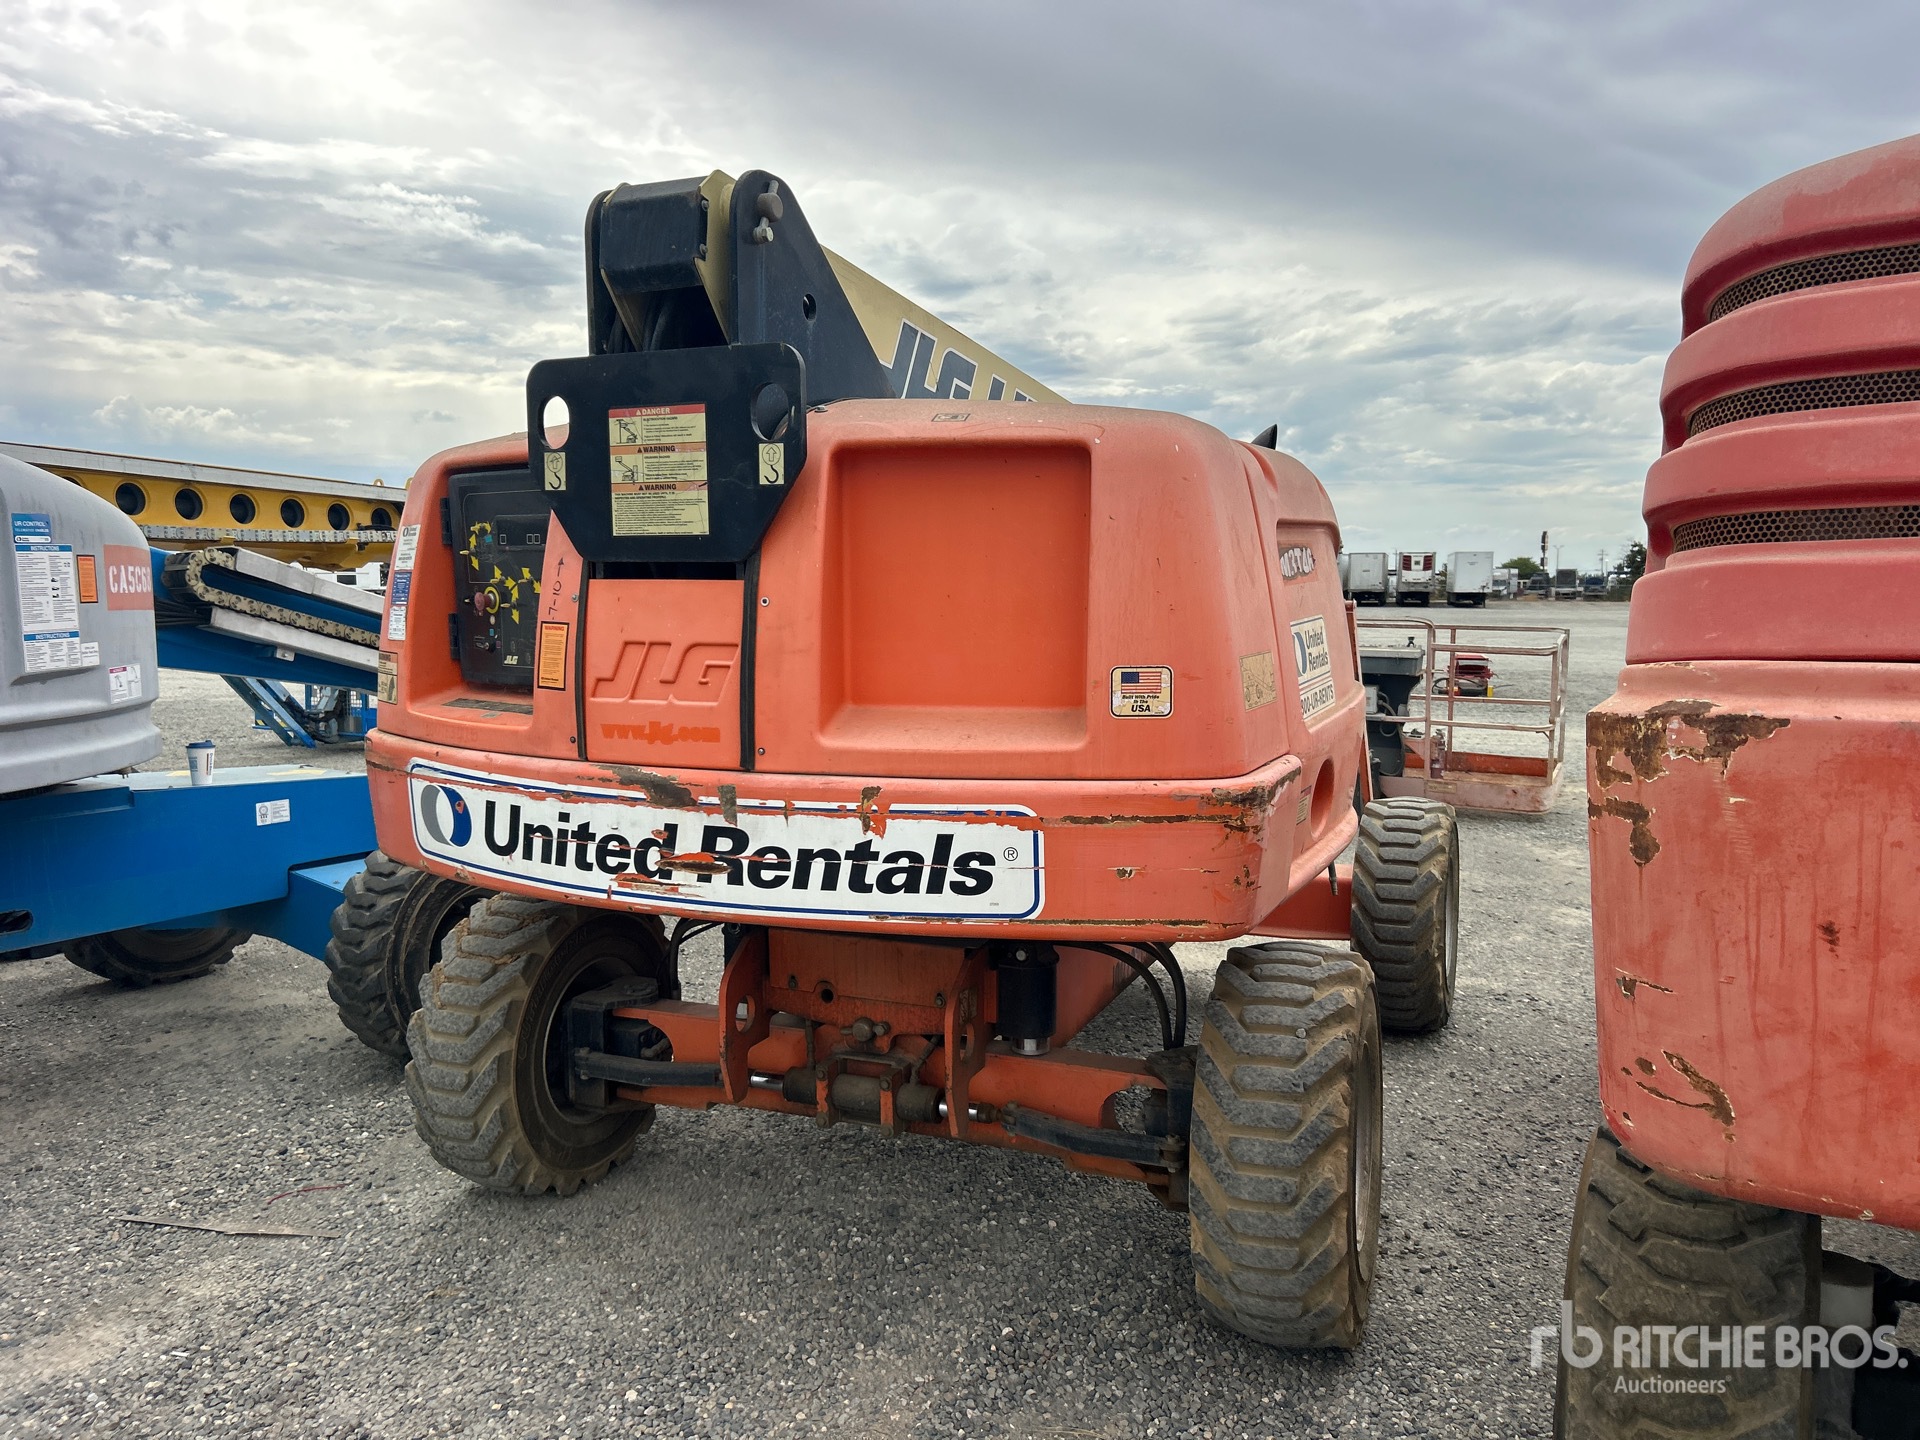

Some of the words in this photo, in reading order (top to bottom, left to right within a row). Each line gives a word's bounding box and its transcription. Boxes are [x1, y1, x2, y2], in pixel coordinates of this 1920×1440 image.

[642, 407, 671, 416] DANGER
[643, 445, 676, 453] WARNING
[644, 483, 677, 491] WARNING
[35, 632, 70, 640] INSTRUCTIONS
[1304, 626, 1325, 650] United
[1308, 648, 1329, 672] Rentals
[591, 641, 739, 706] JLG
[1131, 704, 1151, 713] USA
[484, 800, 679, 881] United
[696, 824, 996, 896] Rentals
